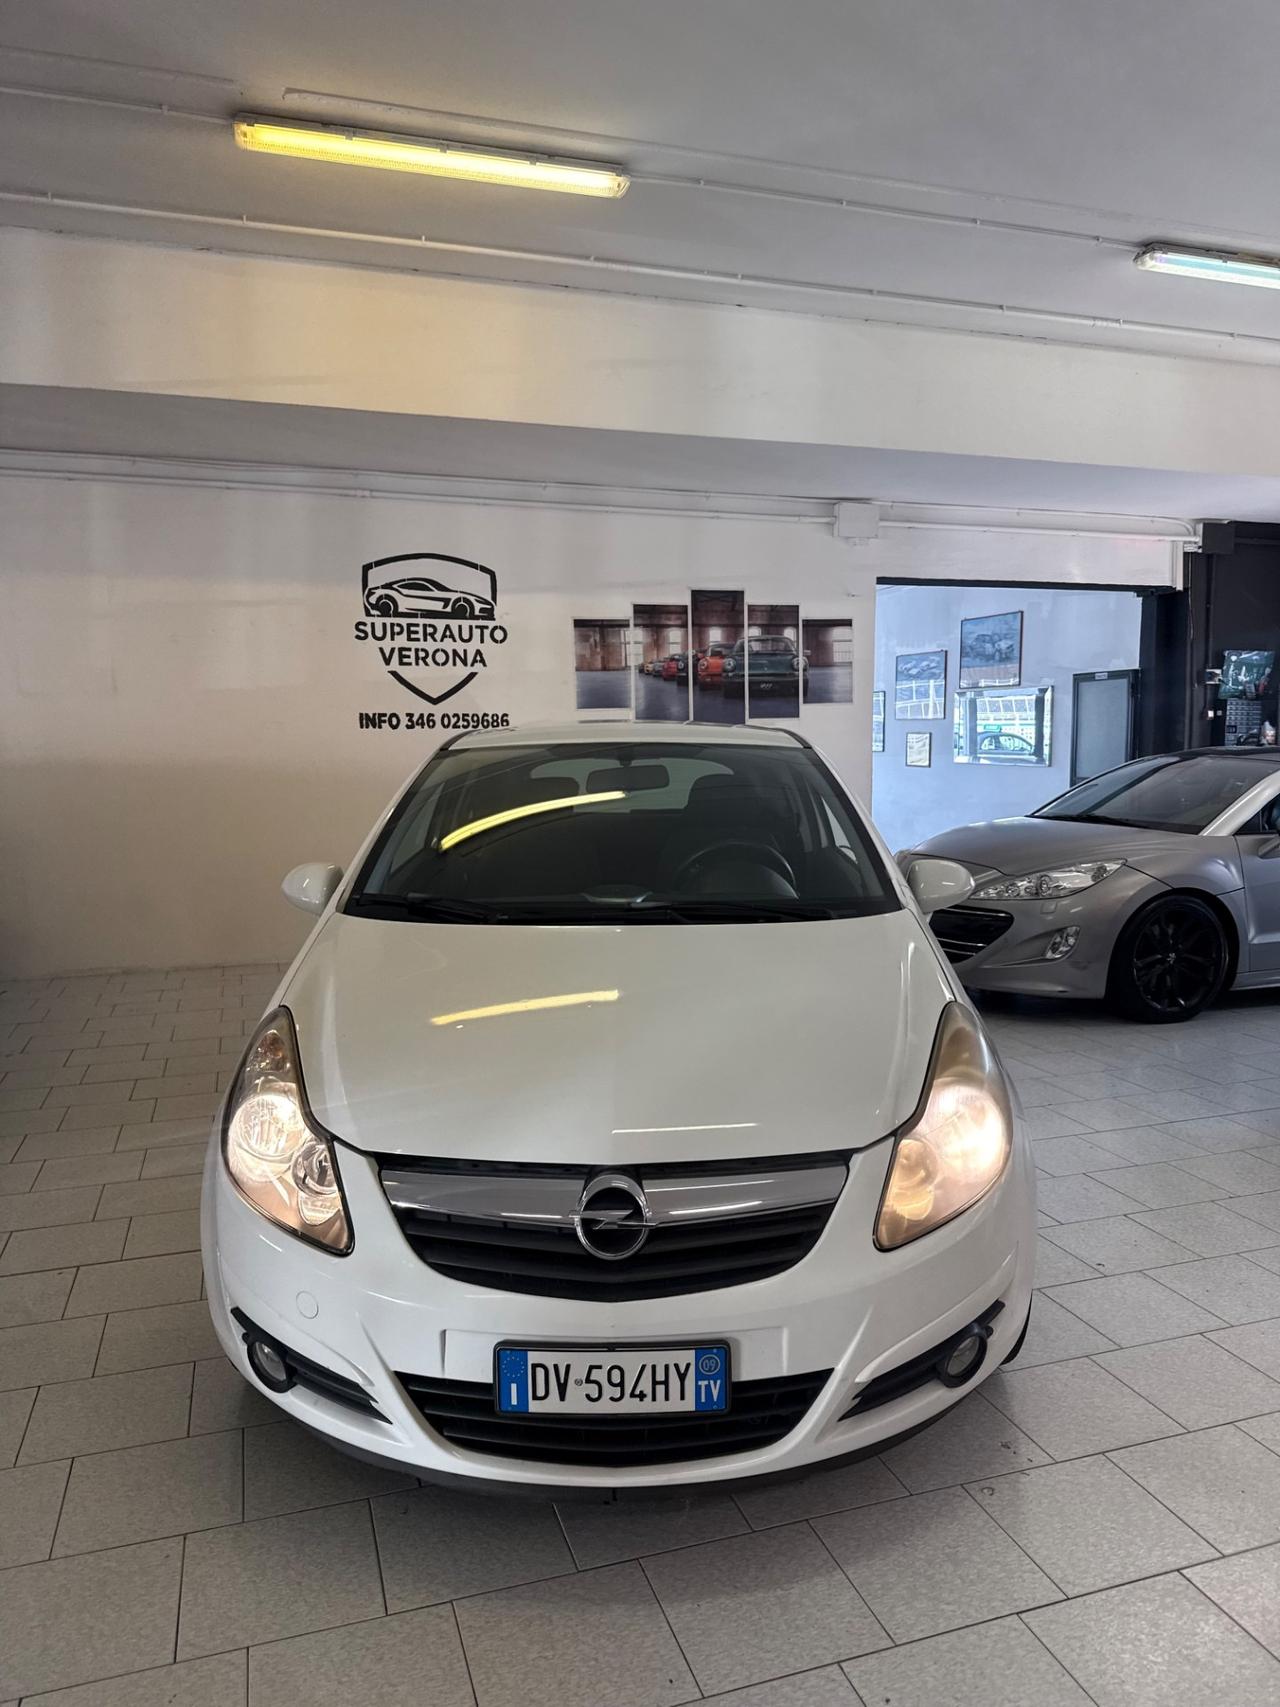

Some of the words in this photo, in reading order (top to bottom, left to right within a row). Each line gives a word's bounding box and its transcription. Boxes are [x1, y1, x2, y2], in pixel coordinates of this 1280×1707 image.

[354, 621, 508, 644] SUPERAUTO
[378, 647, 487, 667] VERONA
[359, 712, 400, 730] INFO
[405, 713, 436, 730] 346
[440, 713, 510, 729] 0259686
[698, 1380, 721, 1402] TV
